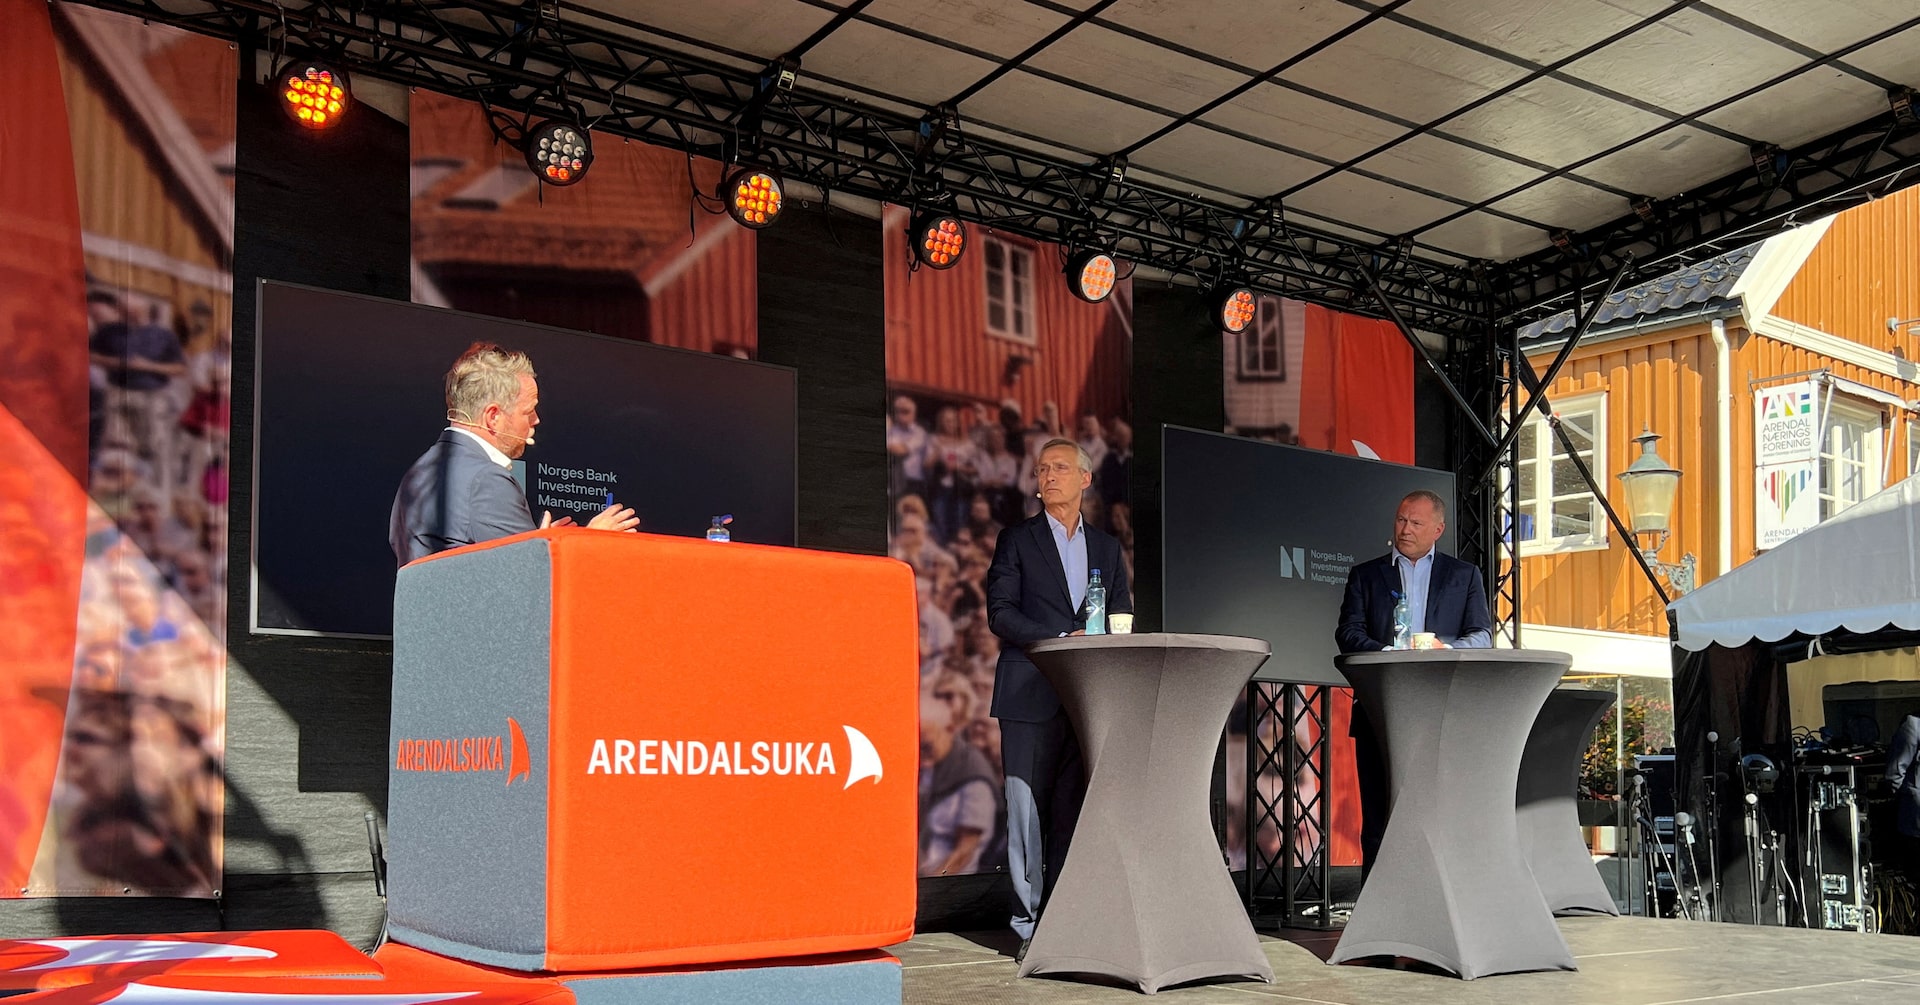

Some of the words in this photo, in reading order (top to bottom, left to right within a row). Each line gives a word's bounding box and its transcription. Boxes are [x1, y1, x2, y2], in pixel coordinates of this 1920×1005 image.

[1763, 417, 1811, 433] ARENDAL
[1763, 427, 1811, 443] NÆRINGS
[1763, 437, 1811, 453] FORENING
[538, 462, 584, 480] Norges
[586, 468, 617, 484] Bank
[538, 478, 608, 498] Investment
[538, 494, 609, 512] Manageme
[1310, 549, 1337, 562] Norges
[1337, 552, 1355, 563] Bank
[1310, 561, 1349, 573] Investment
[1310, 572, 1348, 585] Managem
[396, 736, 504, 773] ARENDALSUKA
[587, 738, 836, 776] ARENDALSUKA
